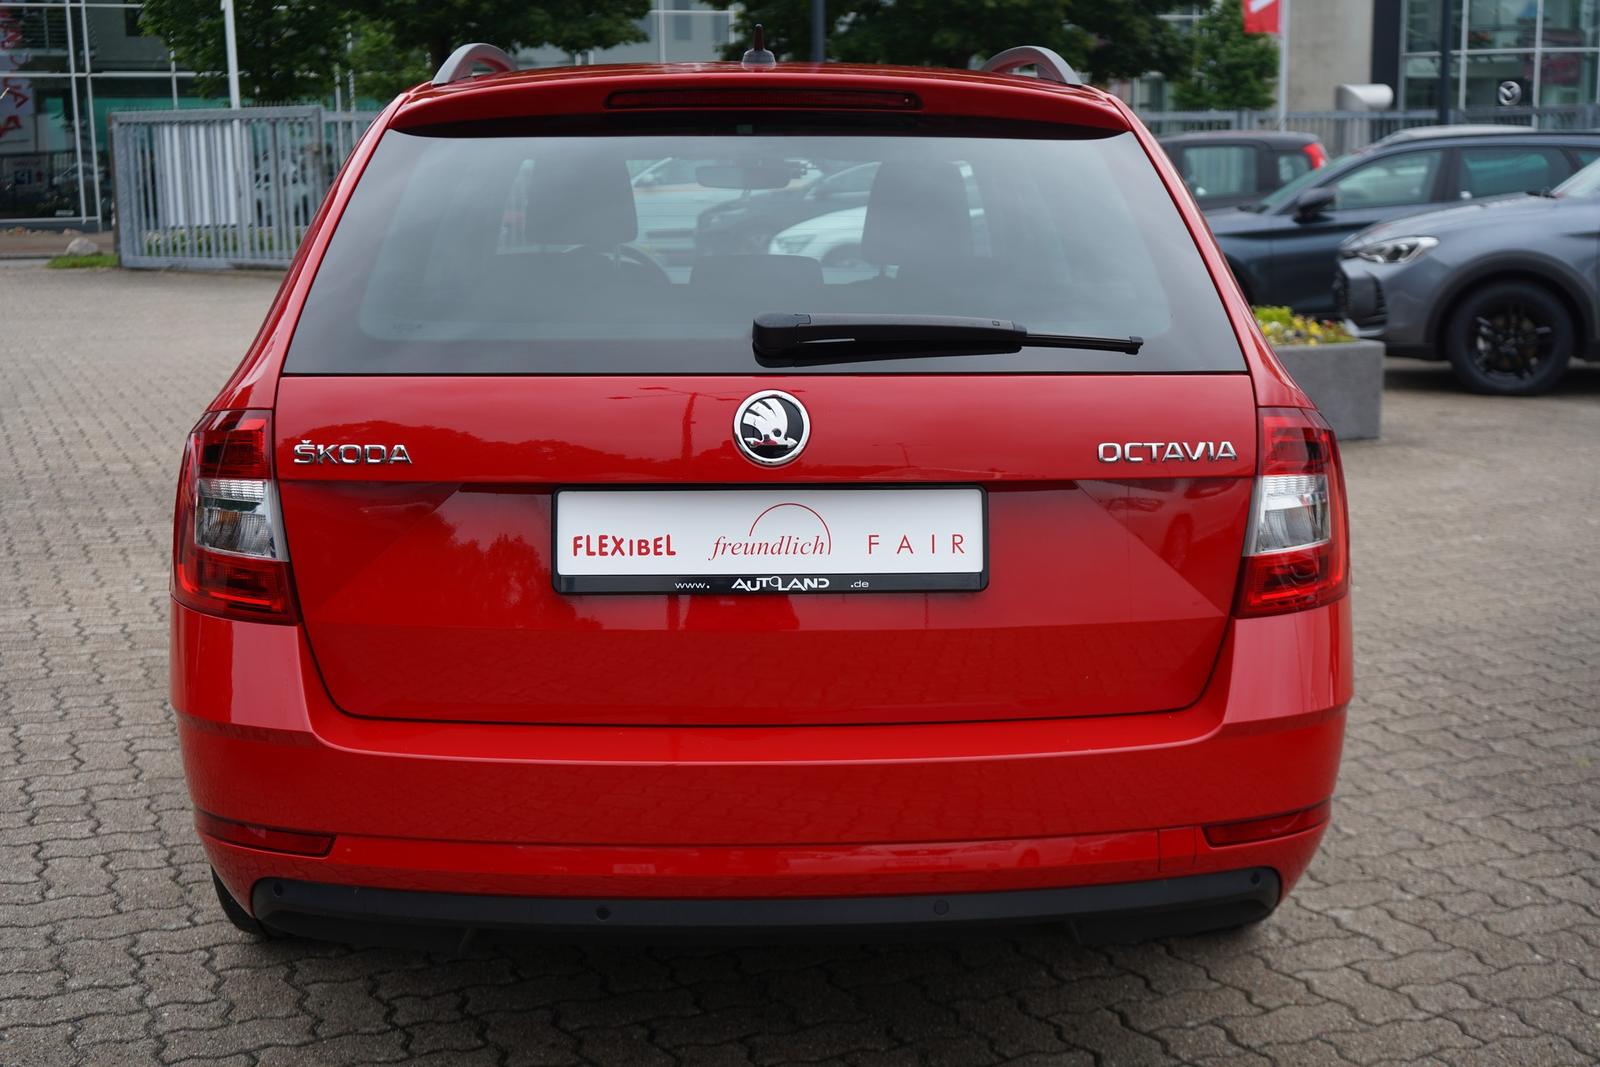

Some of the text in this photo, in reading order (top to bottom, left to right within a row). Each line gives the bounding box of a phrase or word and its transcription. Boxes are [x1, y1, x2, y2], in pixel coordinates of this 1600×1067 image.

[293, 439, 413, 465] ŠKODA
[1097, 441, 1238, 463] OCTAVIA
[573, 534, 677, 557] FLEXIBEL
[707, 535, 826, 561] freundlich
[730, 575, 831, 592] AUTOLAND
